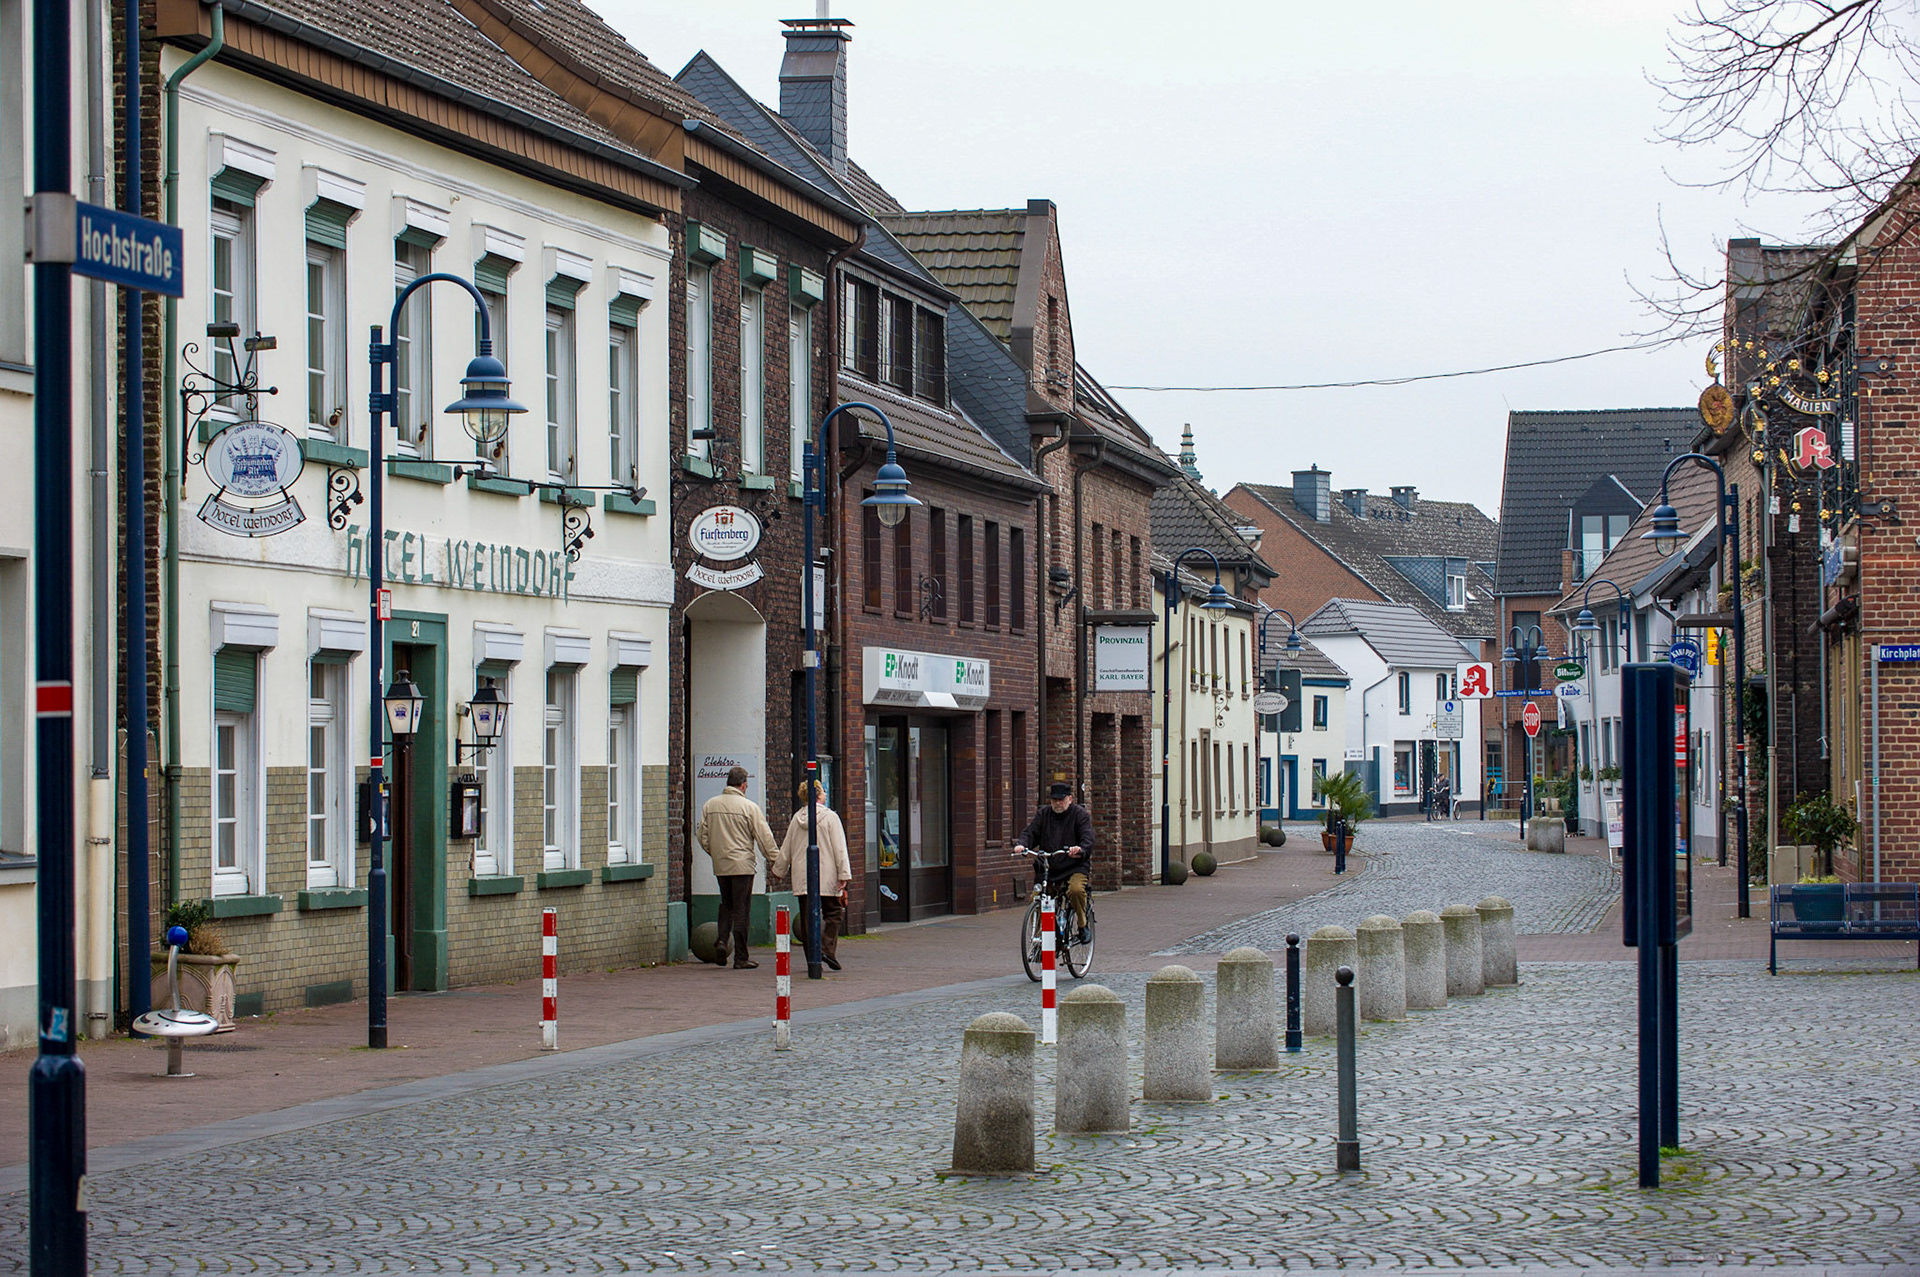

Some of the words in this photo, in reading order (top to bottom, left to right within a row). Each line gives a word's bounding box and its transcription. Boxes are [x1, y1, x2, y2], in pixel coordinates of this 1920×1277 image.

[81, 216, 172, 279] Hochstraße
[1783, 390, 1831, 412] MARIEN
[237, 457, 272, 466] Schumacher
[248, 466, 259, 475] Alt
[701, 528, 749, 541] Fürstenberg
[446, 538, 577, 608] WEINDORF
[411, 620, 420, 637] 21
[1100, 636, 1144, 644] PROVINZIAL
[1557, 668, 1581, 677] Bitburger
[1560, 687, 1581, 696] Taube
[1525, 713, 1539, 727] STOP
